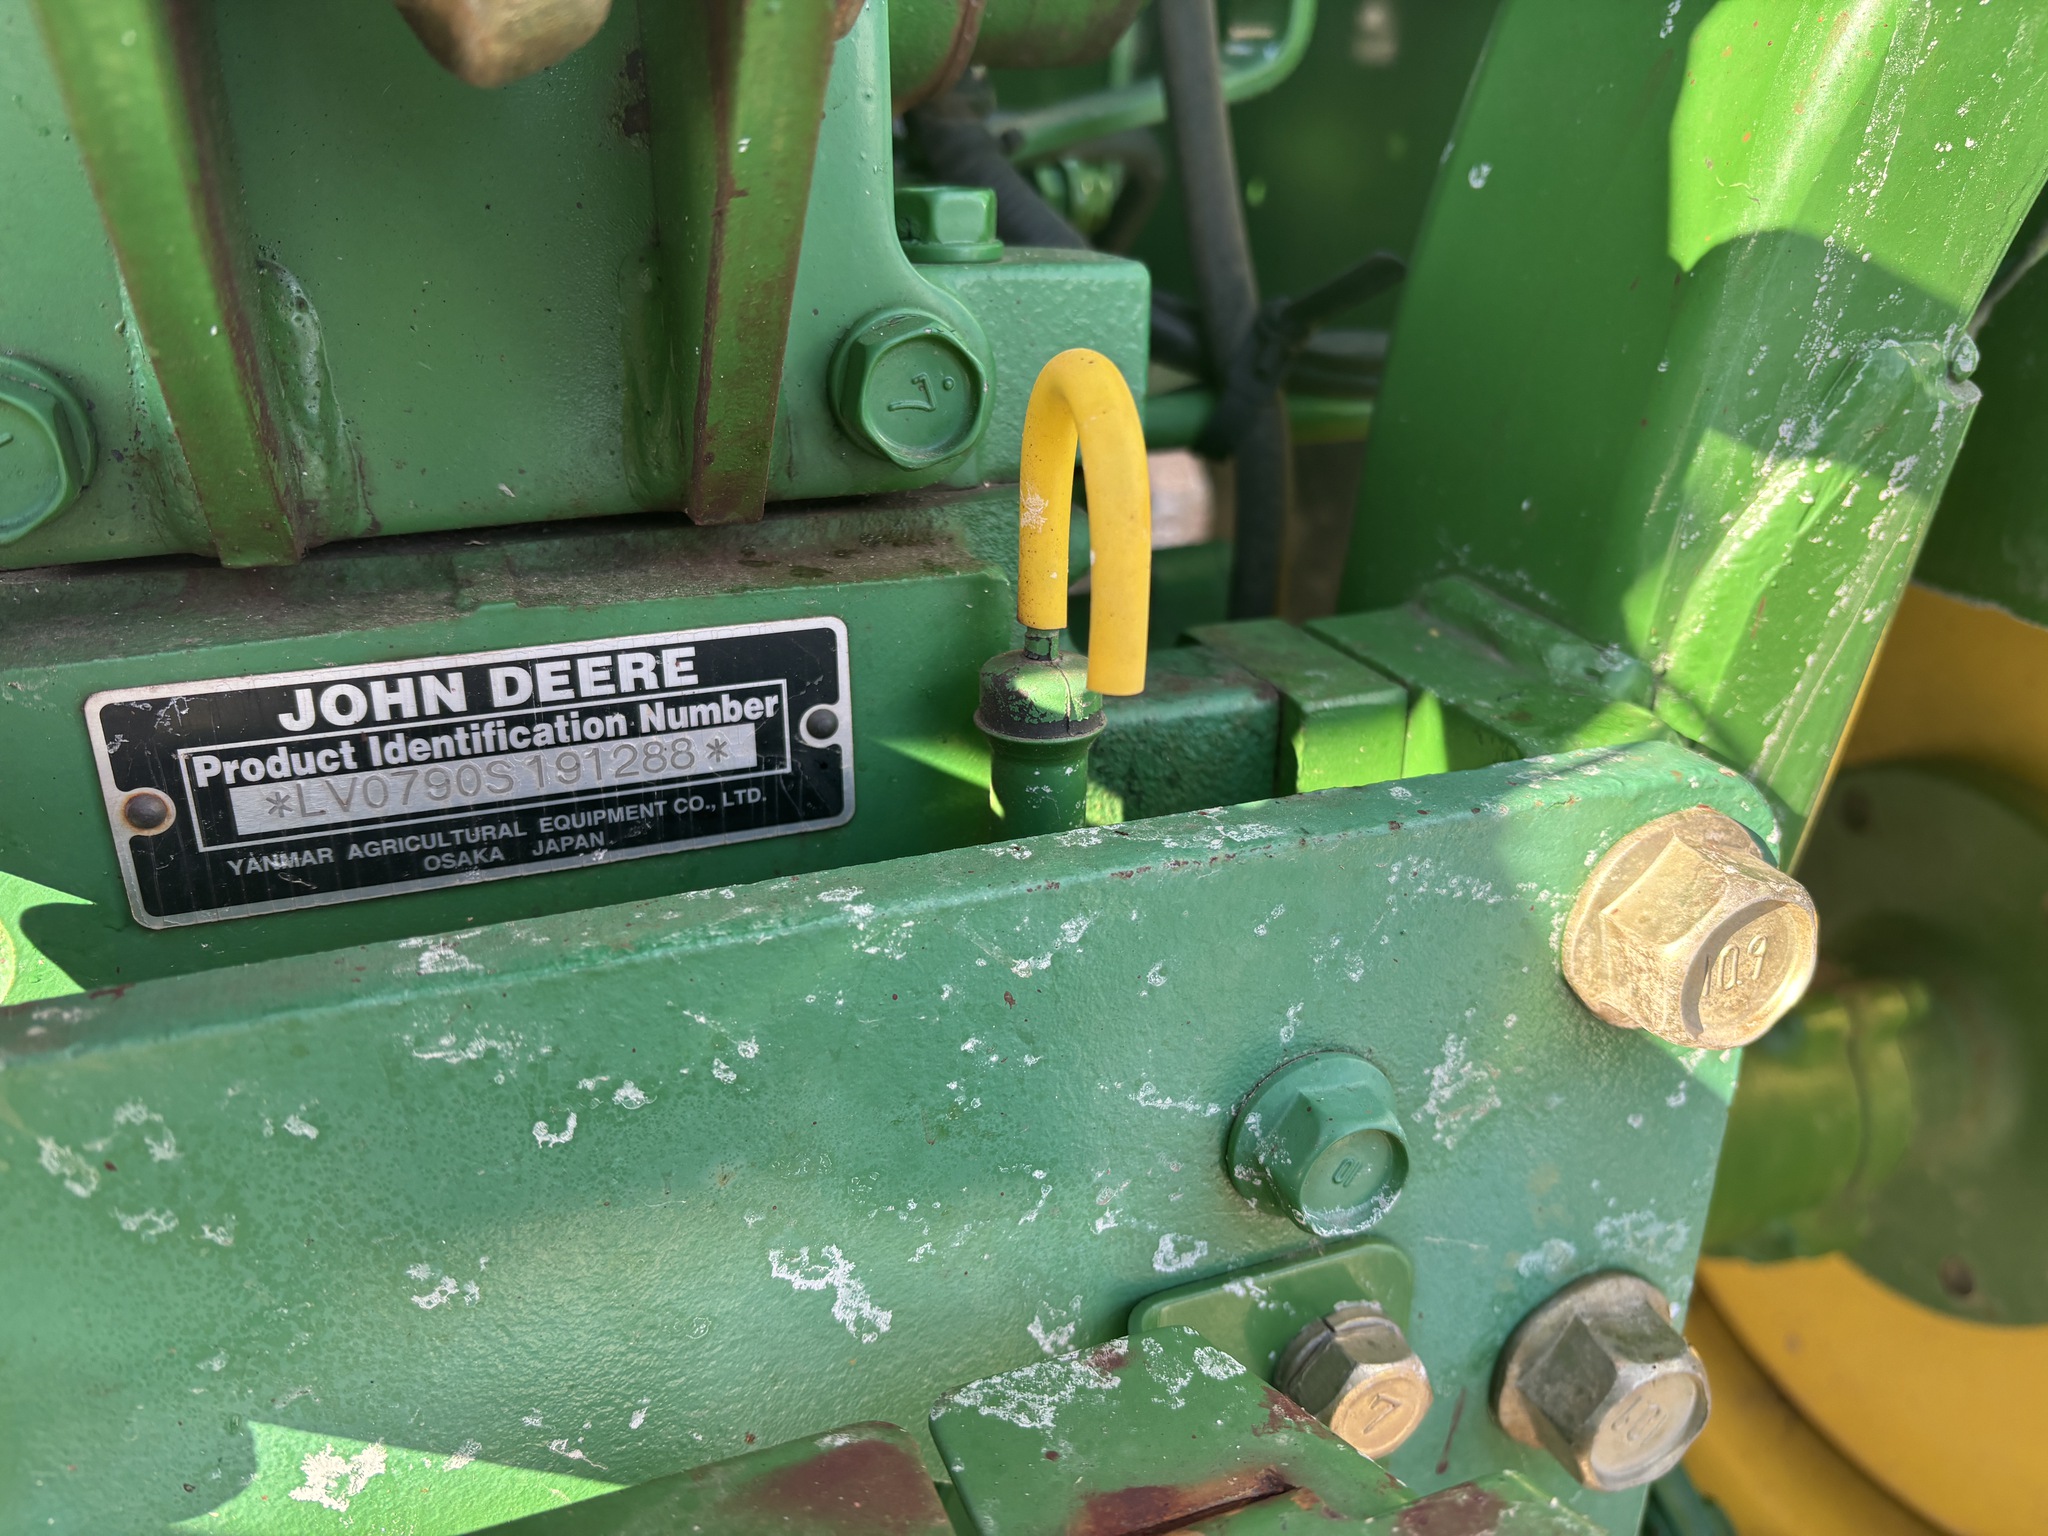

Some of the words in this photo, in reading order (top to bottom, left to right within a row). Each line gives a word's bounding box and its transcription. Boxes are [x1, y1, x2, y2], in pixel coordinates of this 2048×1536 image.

[278, 672, 468, 732] JOHN
[489, 646, 699, 708] DEERE
[192, 740, 358, 788] Product
[369, 710, 629, 767] Identification
[639, 693, 780, 734] Number
[228, 848, 335, 876] YANMAR
[348, 820, 528, 860] AGRICULTURAL
[540, 801, 668, 833] EQUIPMENT
[674, 796, 717, 814] CO.,
[722, 788, 768, 808] LTD.
[424, 848, 505, 872] OSAKA
[532, 831, 605, 857] JAPAN
